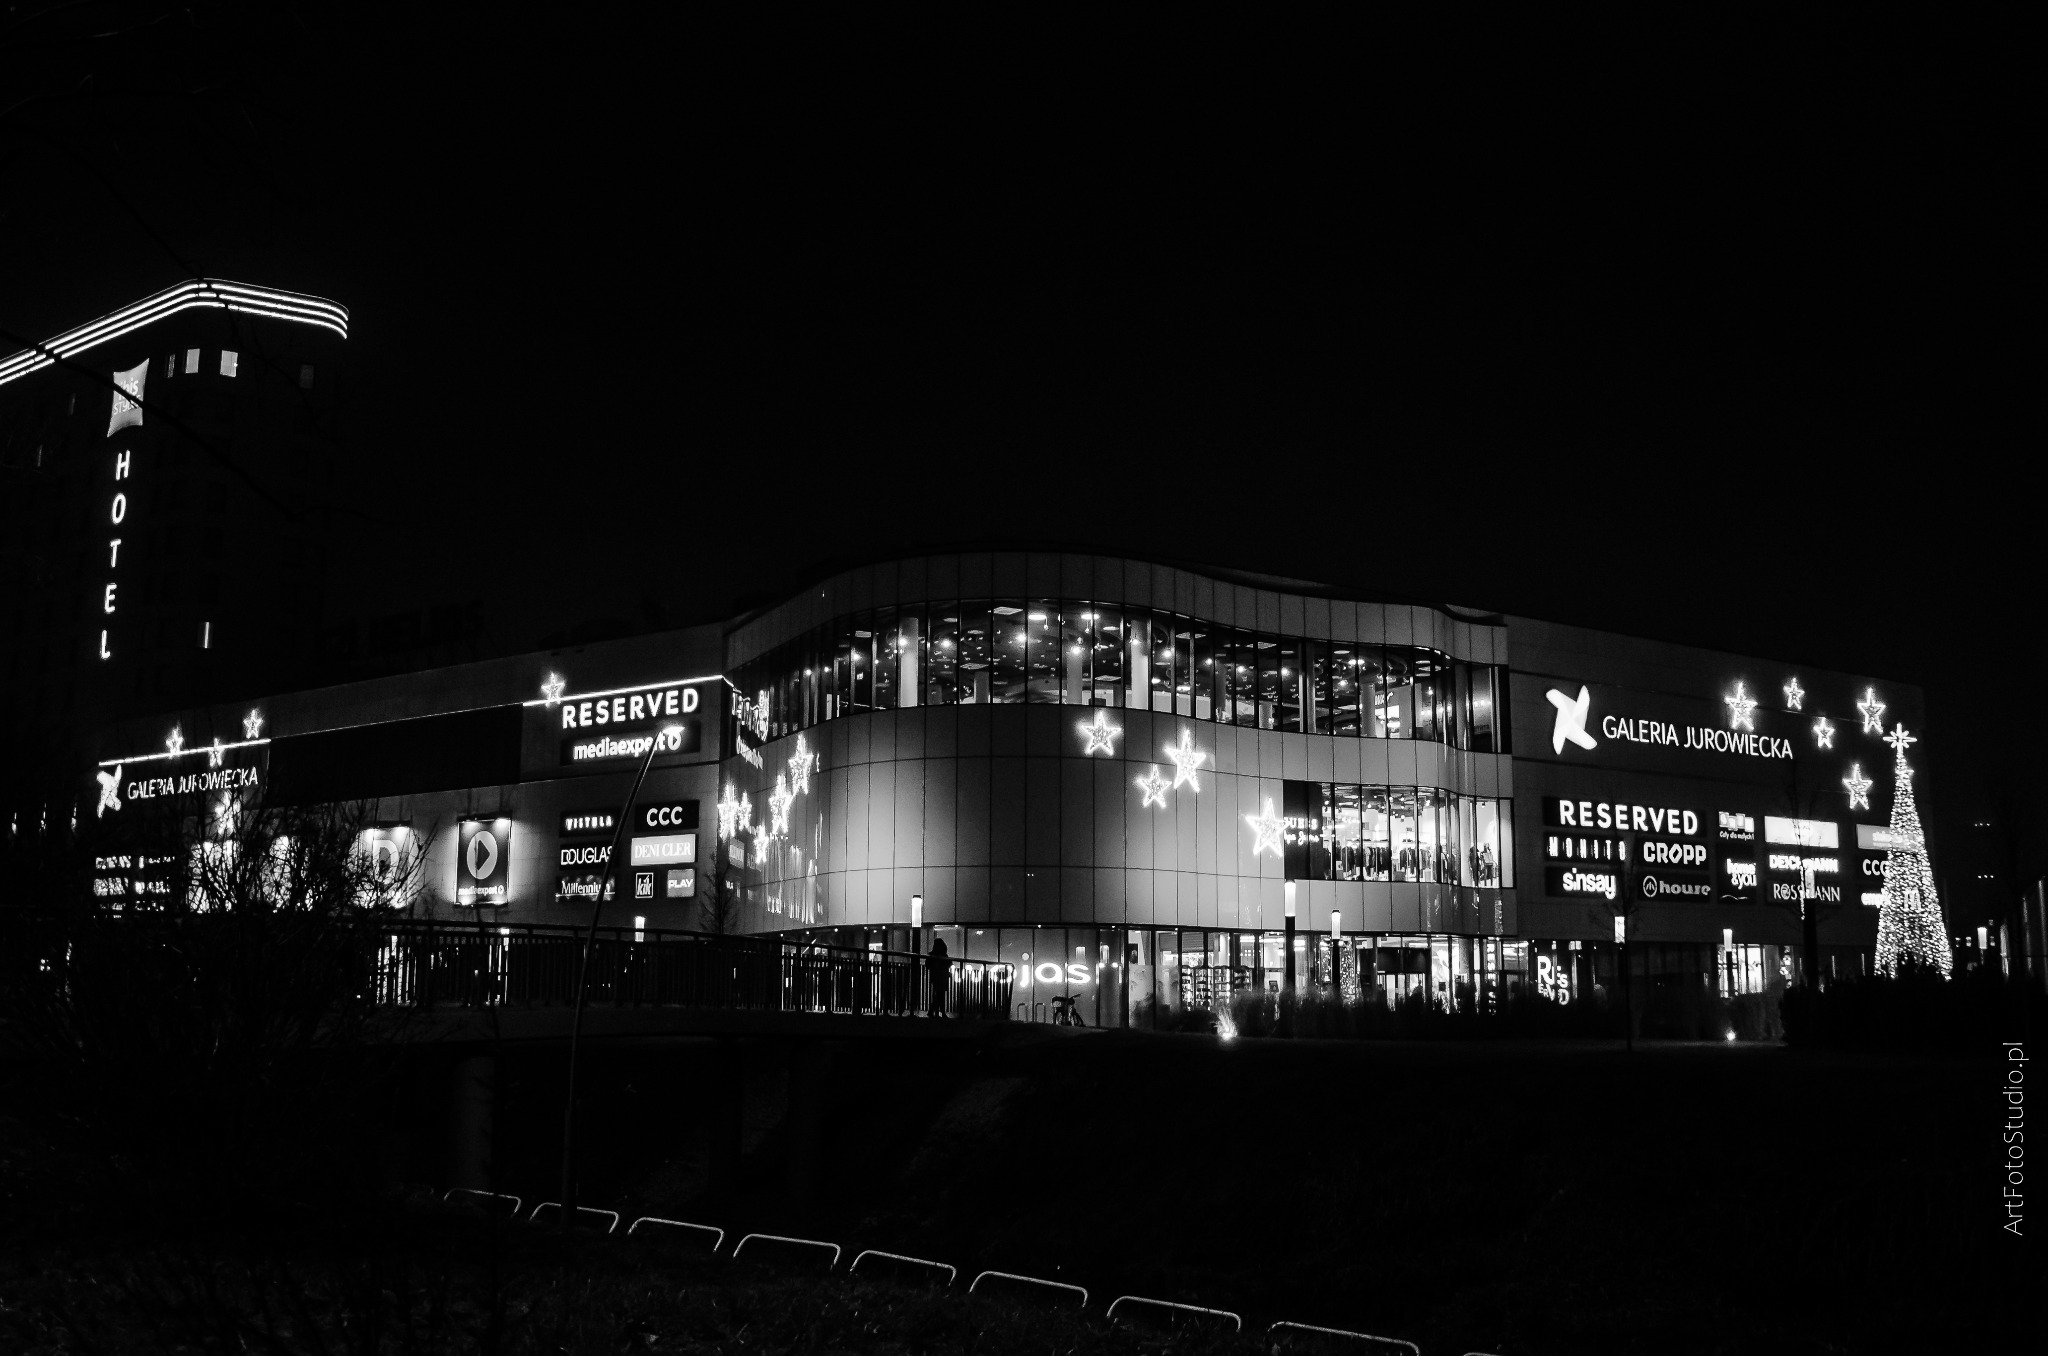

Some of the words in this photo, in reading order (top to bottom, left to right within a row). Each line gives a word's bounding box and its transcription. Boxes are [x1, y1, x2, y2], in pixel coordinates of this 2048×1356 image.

[100, 449, 131, 660] HOTEL
[562, 688, 699, 729] RESERVED
[1602, 715, 1680, 747] GALERIA
[1683, 726, 1793, 760] JUROWIECKA
[128, 777, 175, 800] GALERIA
[565, 815, 614, 831] VISTULA
[646, 806, 683, 827] CCC
[1559, 800, 1698, 835] RESERVED
[634, 844, 660, 859] DENI
[661, 842, 692, 857] CLER
[1548, 836, 1626, 861] MOHITO
[1643, 842, 1707, 865] CROPP
[1727, 859, 1756, 874] home
[637, 874, 652, 896] kik
[668, 878, 694, 889] PLAY
[1562, 867, 1618, 900] sinsay
[1659, 880, 1711, 896] house
[1773, 884, 1841, 902] ROSANN
